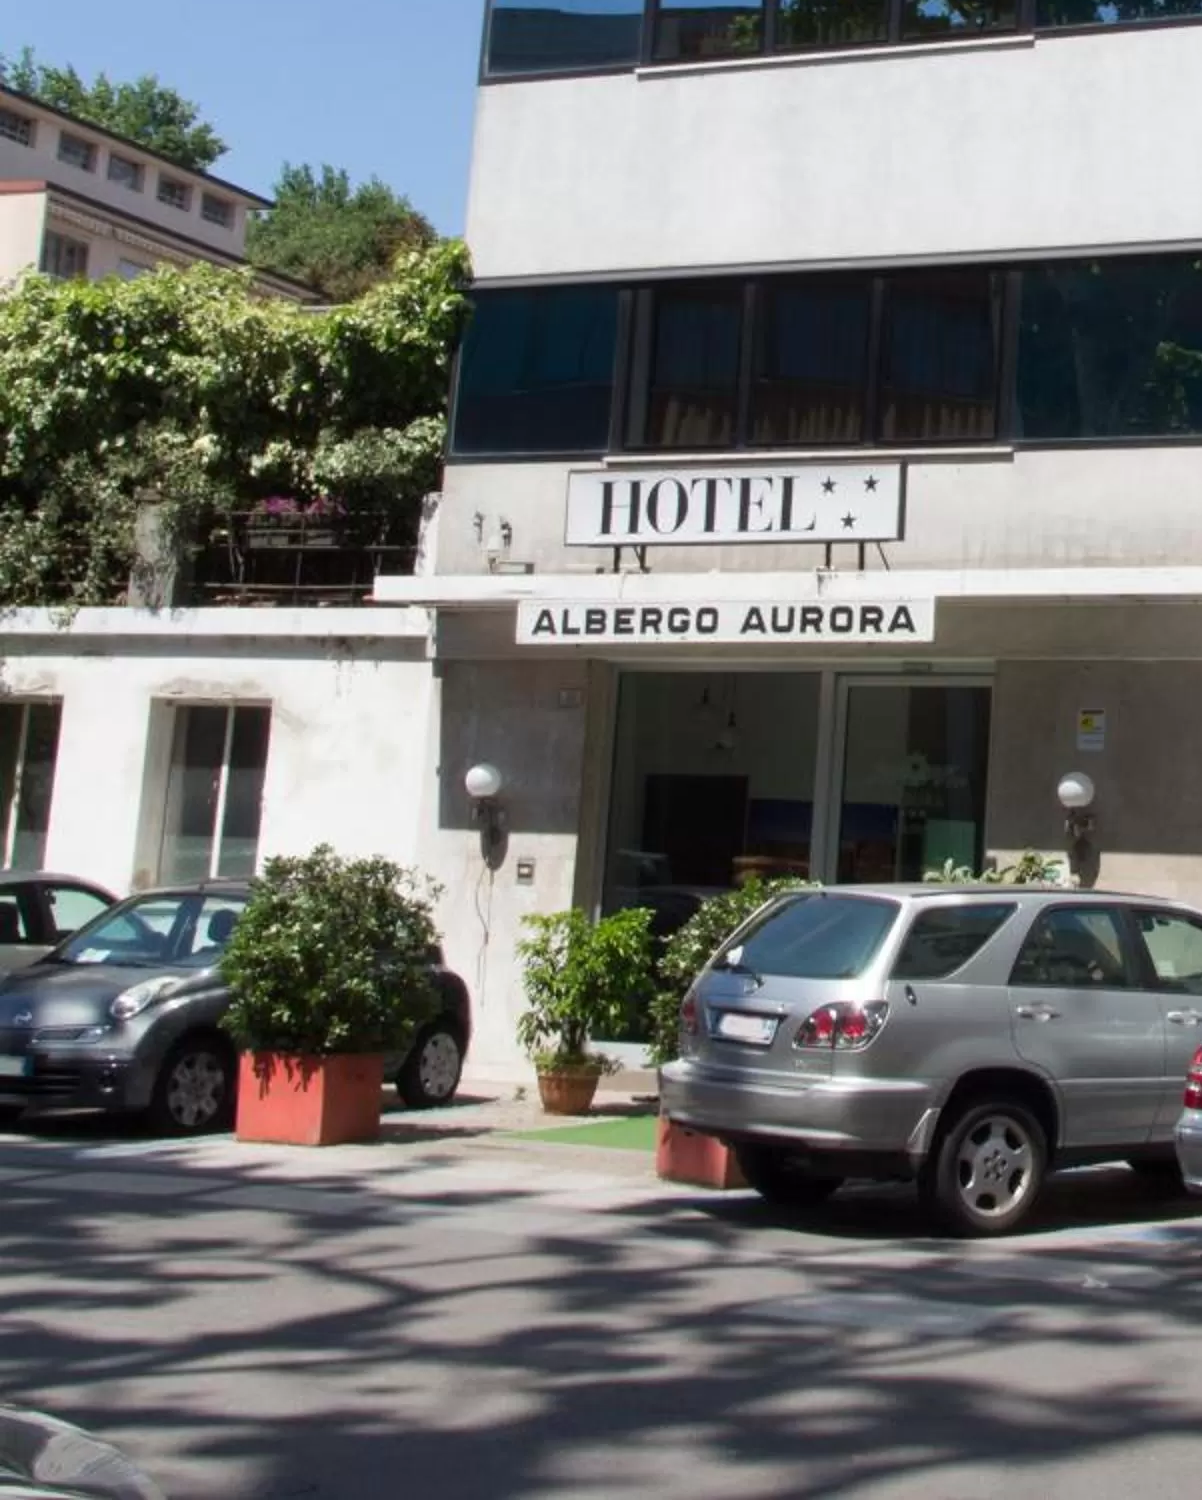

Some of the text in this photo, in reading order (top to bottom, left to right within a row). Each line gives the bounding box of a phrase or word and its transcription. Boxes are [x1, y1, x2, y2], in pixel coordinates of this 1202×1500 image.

[597, 474, 816, 535] HOTEL
[531, 605, 916, 635] ALBERGO AURORA
